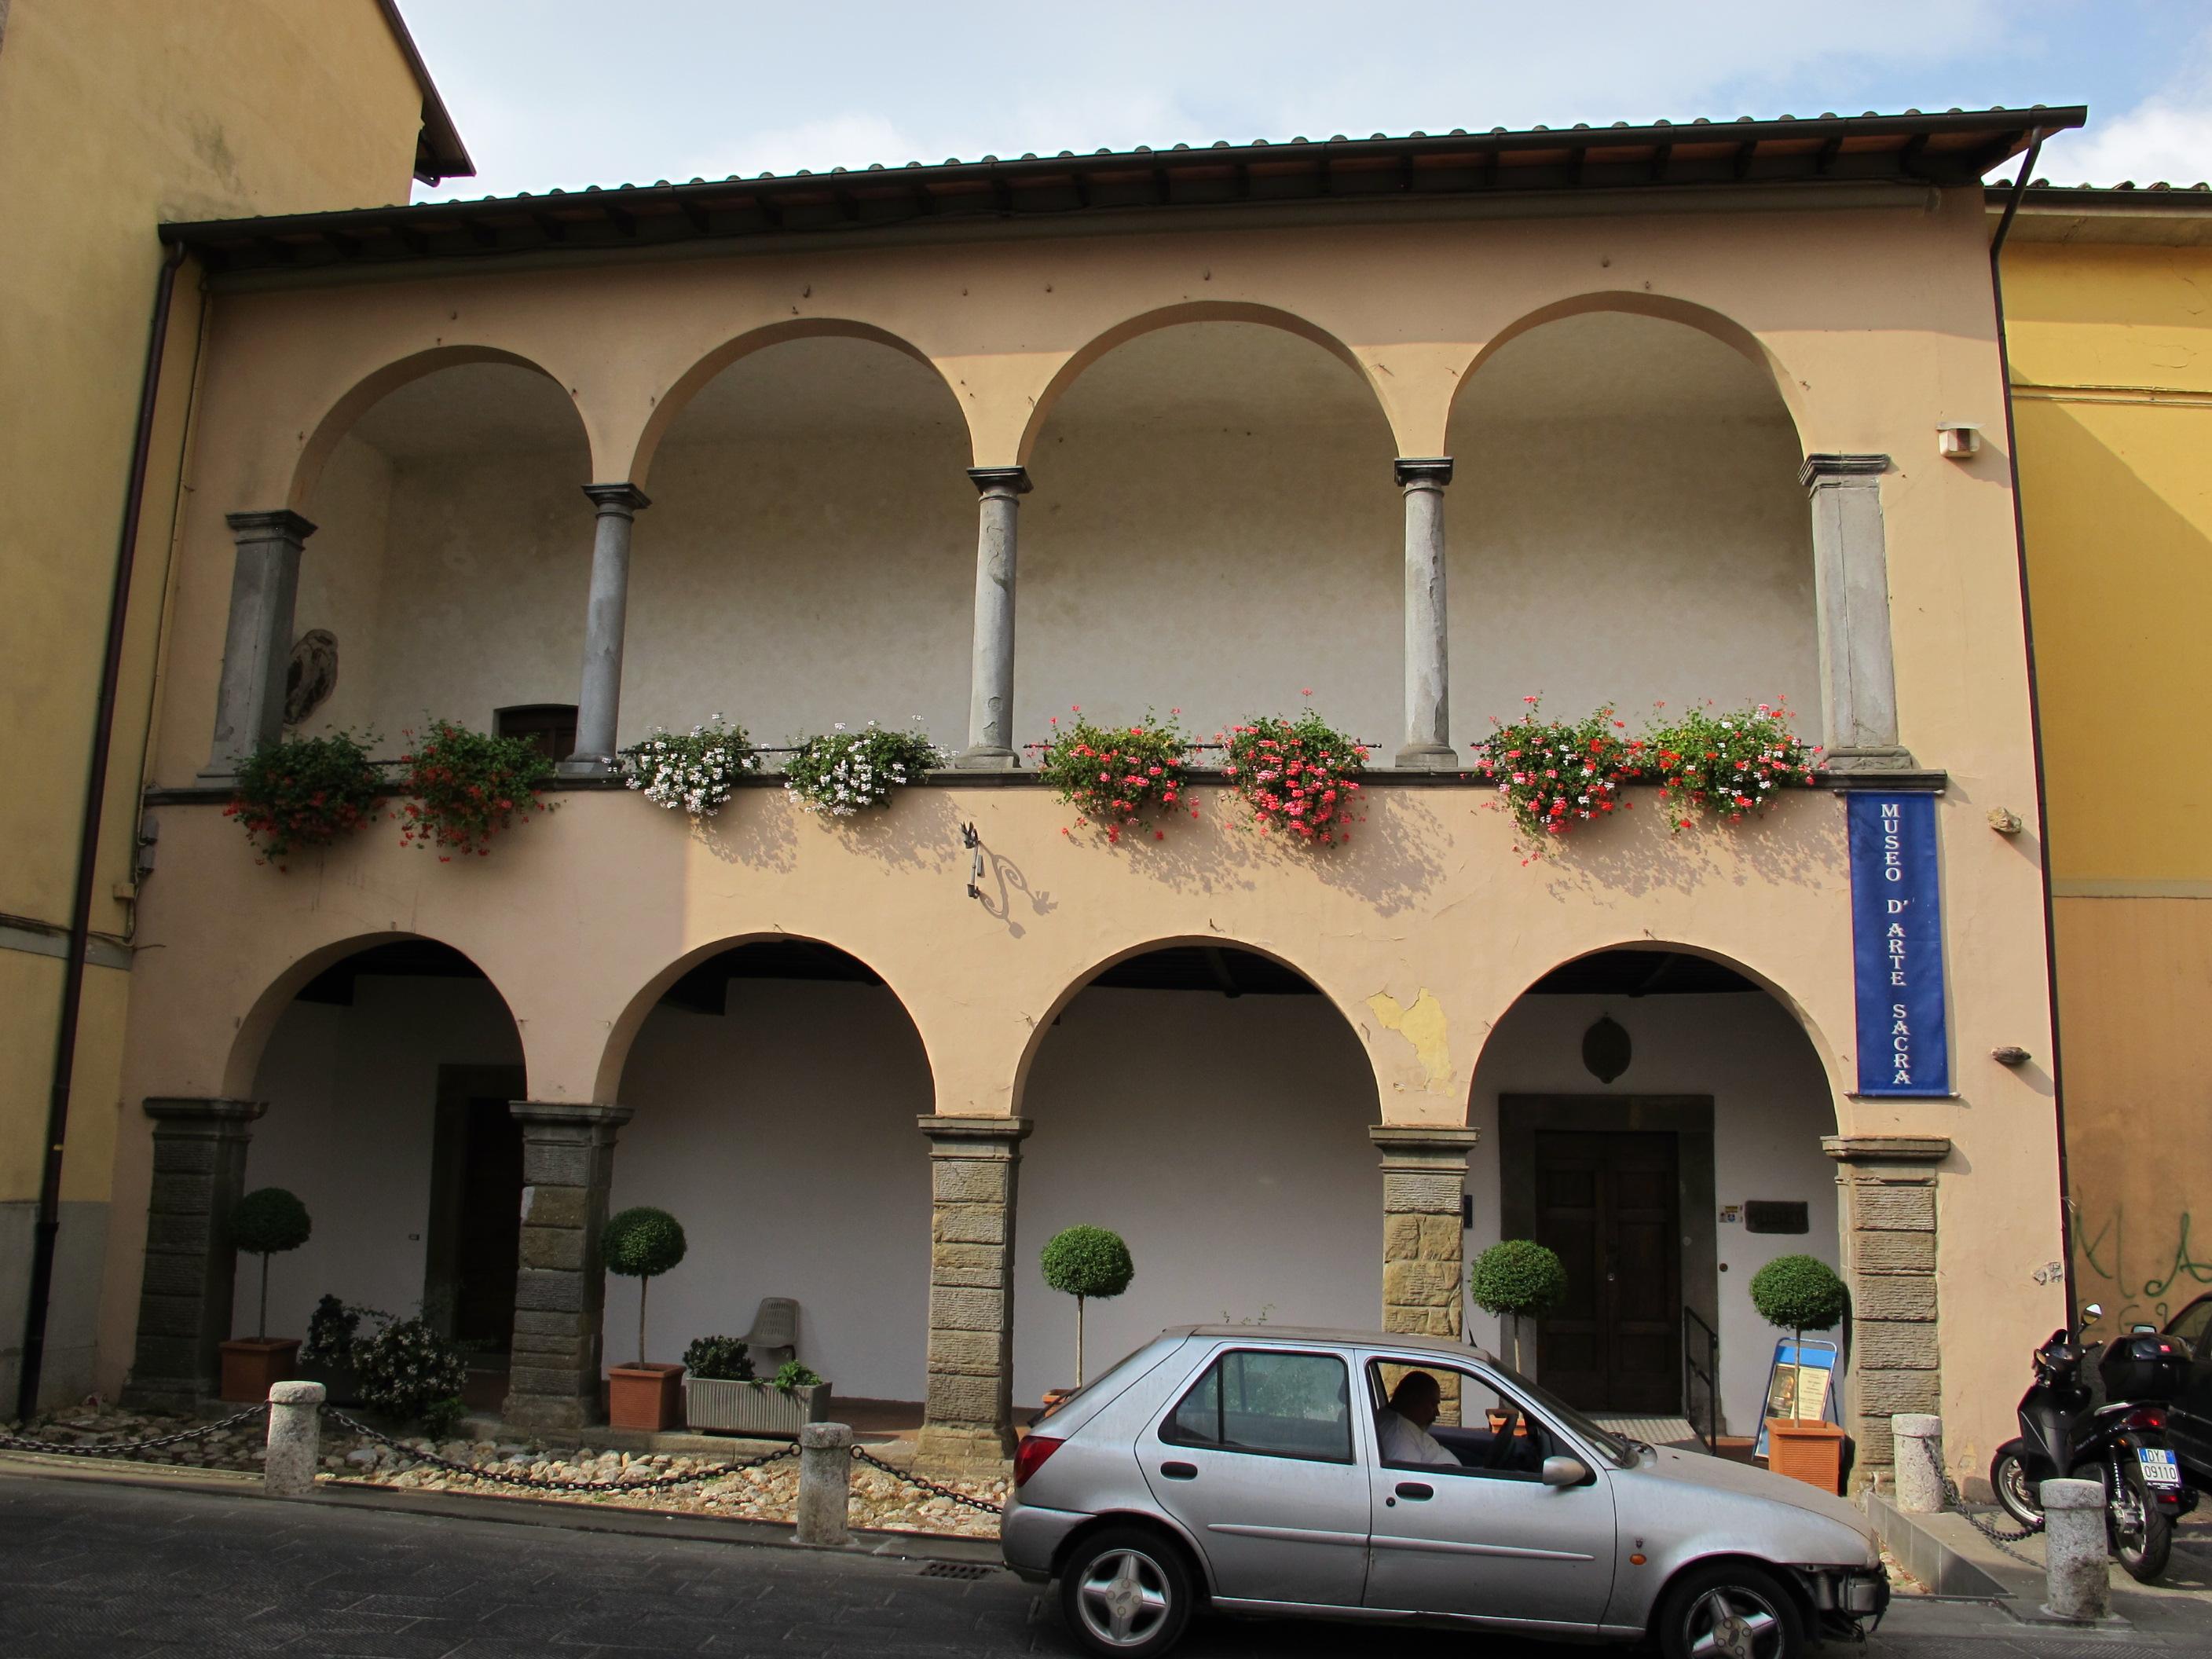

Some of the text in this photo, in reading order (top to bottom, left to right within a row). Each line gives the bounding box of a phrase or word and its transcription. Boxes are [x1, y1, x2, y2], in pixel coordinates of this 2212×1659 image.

[1881, 804, 1901, 881] MUSEO
[1892, 1004, 1910, 1084] SACRA
[2148, 1449, 2160, 1462] DY
[2144, 1465, 2177, 1480] 09110
